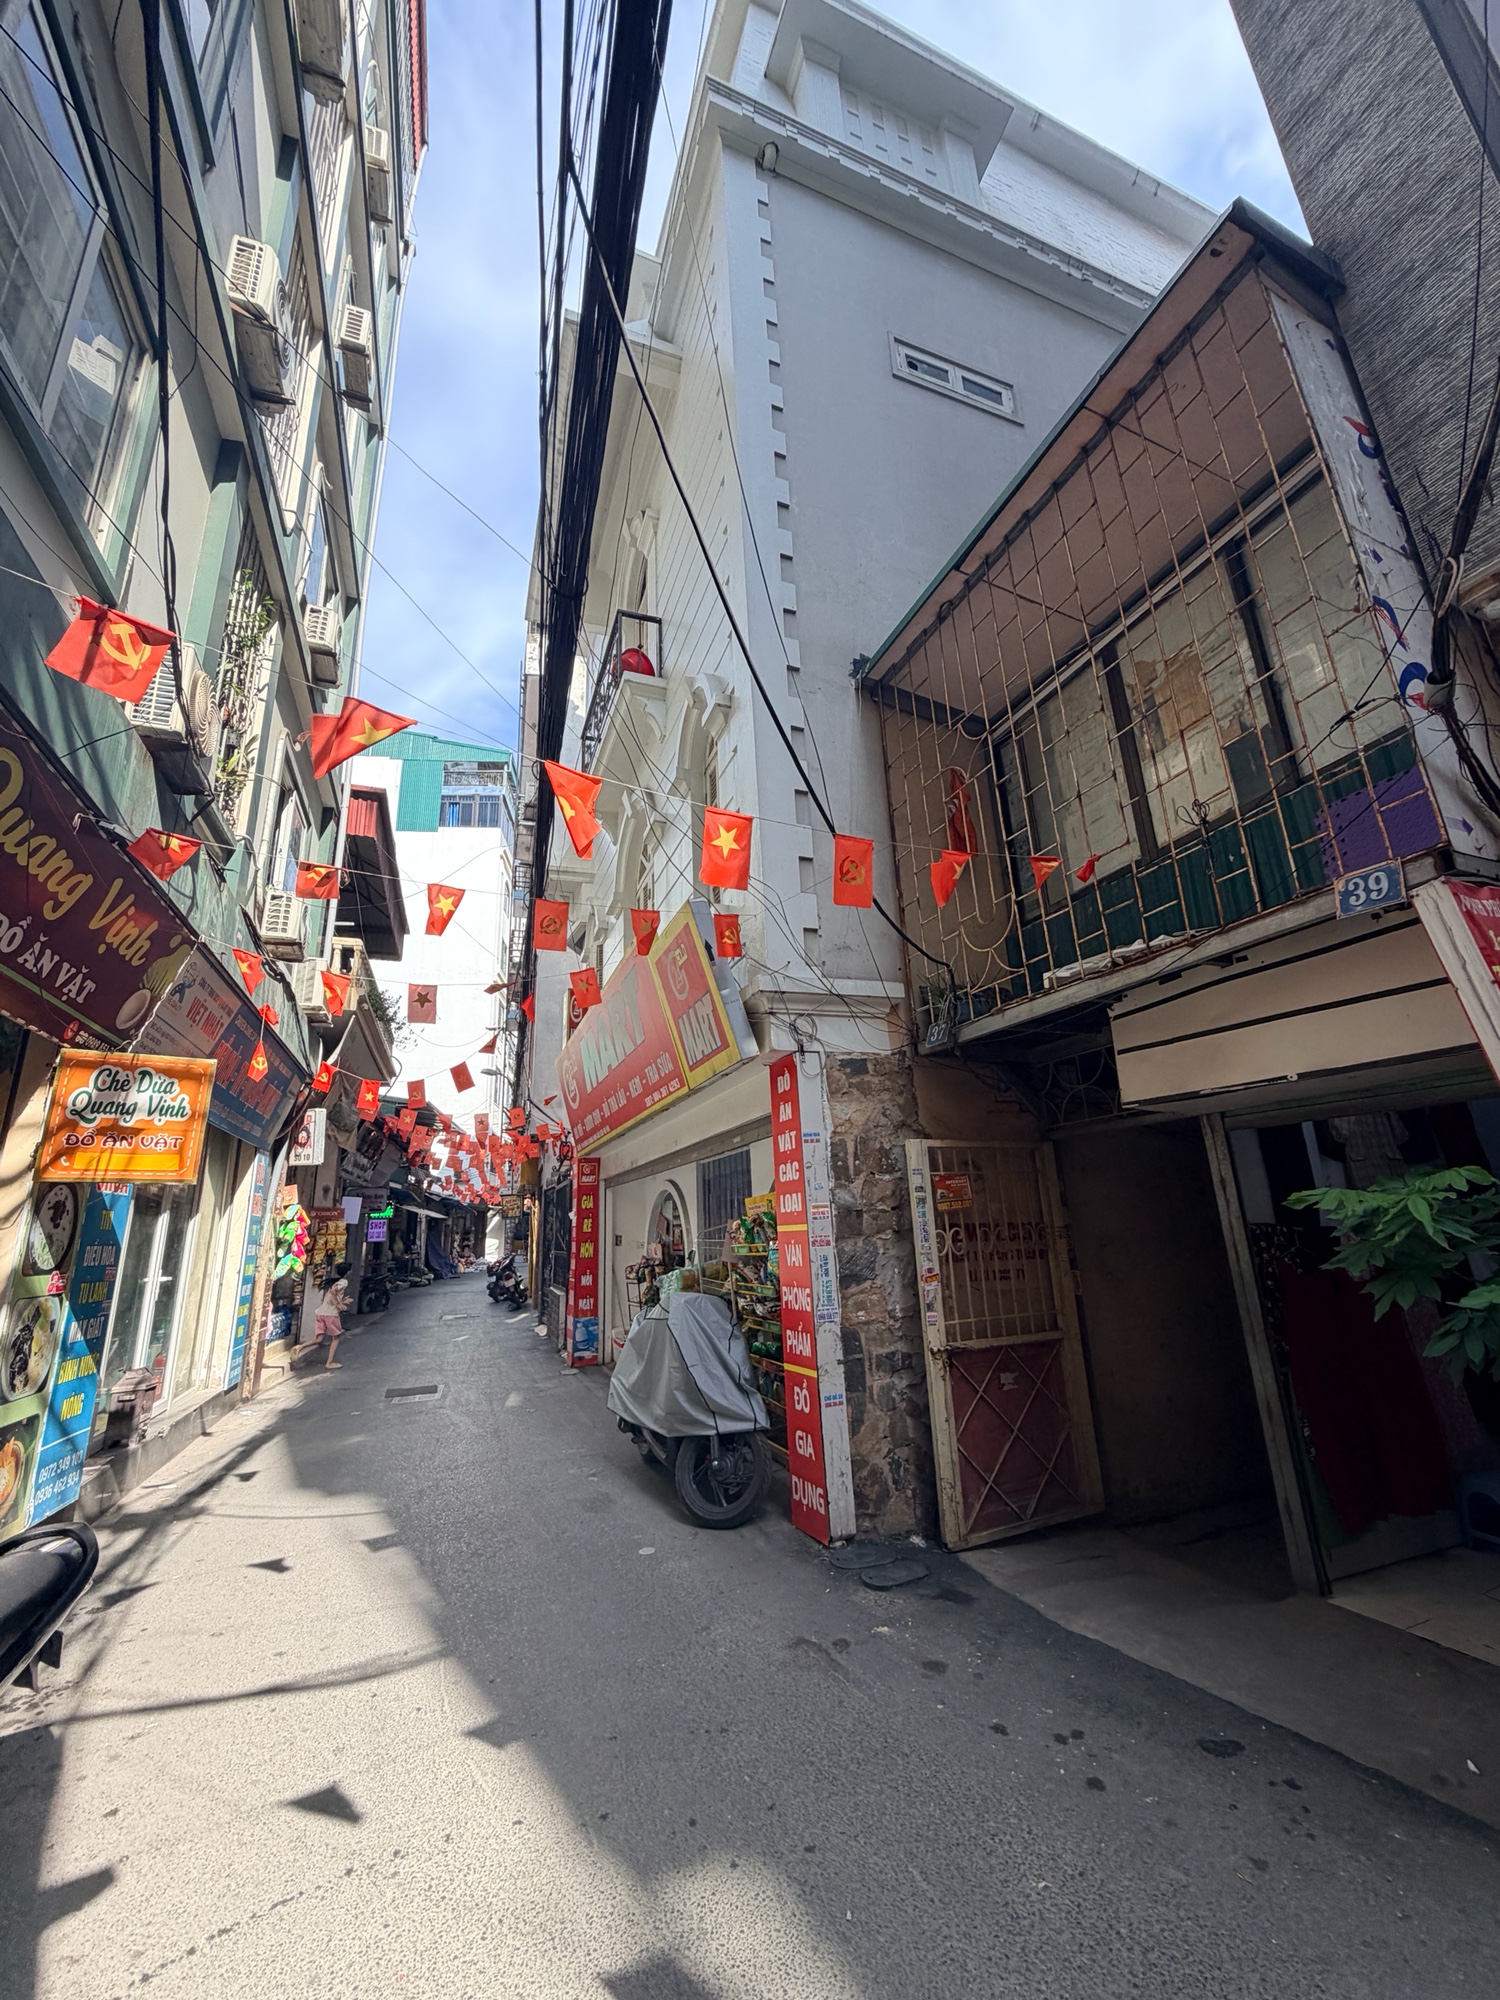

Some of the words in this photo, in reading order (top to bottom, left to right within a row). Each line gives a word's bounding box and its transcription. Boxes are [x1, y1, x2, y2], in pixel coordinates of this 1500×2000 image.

[1347, 871, 1390, 906] 39
[88, 877, 159, 967] Vịnh
[17, 932, 56, 975] ĂN
[54, 963, 97, 1005] VẶT
[186, 995, 208, 1029] VIỆT
[201, 1007, 225, 1043] NHẬT
[580, 963, 646, 1094] MART
[678, 991, 723, 1066] MART
[930, 1024, 947, 1042] 37
[657, 1051, 674, 1077] SỮA
[94, 1068, 132, 1093] Chè
[136, 1069, 177, 1095] Dừa
[777, 1067, 791, 1093] ĐỒ
[70, 1090, 139, 1125] Quang
[148, 1095, 189, 1123] Vịnh
[779, 1101, 792, 1123] ĂN
[64, 1129, 97, 1148] ĐỒ
[102, 1132, 134, 1149] ĂN
[139, 1133, 183, 1152] VẶT
[778, 1130, 796, 1153] VẶT
[779, 1159, 799, 1183] CÁC
[581, 1191, 594, 1210] GIÁ
[780, 1191, 802, 1217] LOẠI
[370, 1221, 386, 1230] SHOP
[582, 1214, 593, 1233] RẺ
[83, 1238, 100, 1266] ĐIỀU
[101, 1240, 116, 1266] HÒA
[78, 1276, 90, 1304] TỦ
[90, 1280, 110, 1308] LẠNH
[782, 1284, 812, 1312] PHÒNG
[68, 1315, 86, 1344] MÁY
[87, 1313, 105, 1343] GIẶT
[786, 1322, 812, 1358] PHẨM
[58, 1355, 78, 1385] BÌNH
[60, 1392, 85, 1422] NÓNG
[793, 1378, 811, 1414] ĐỒ
[795, 1430, 815, 1461] GIA
[791, 1475, 826, 1515] DỤNG
